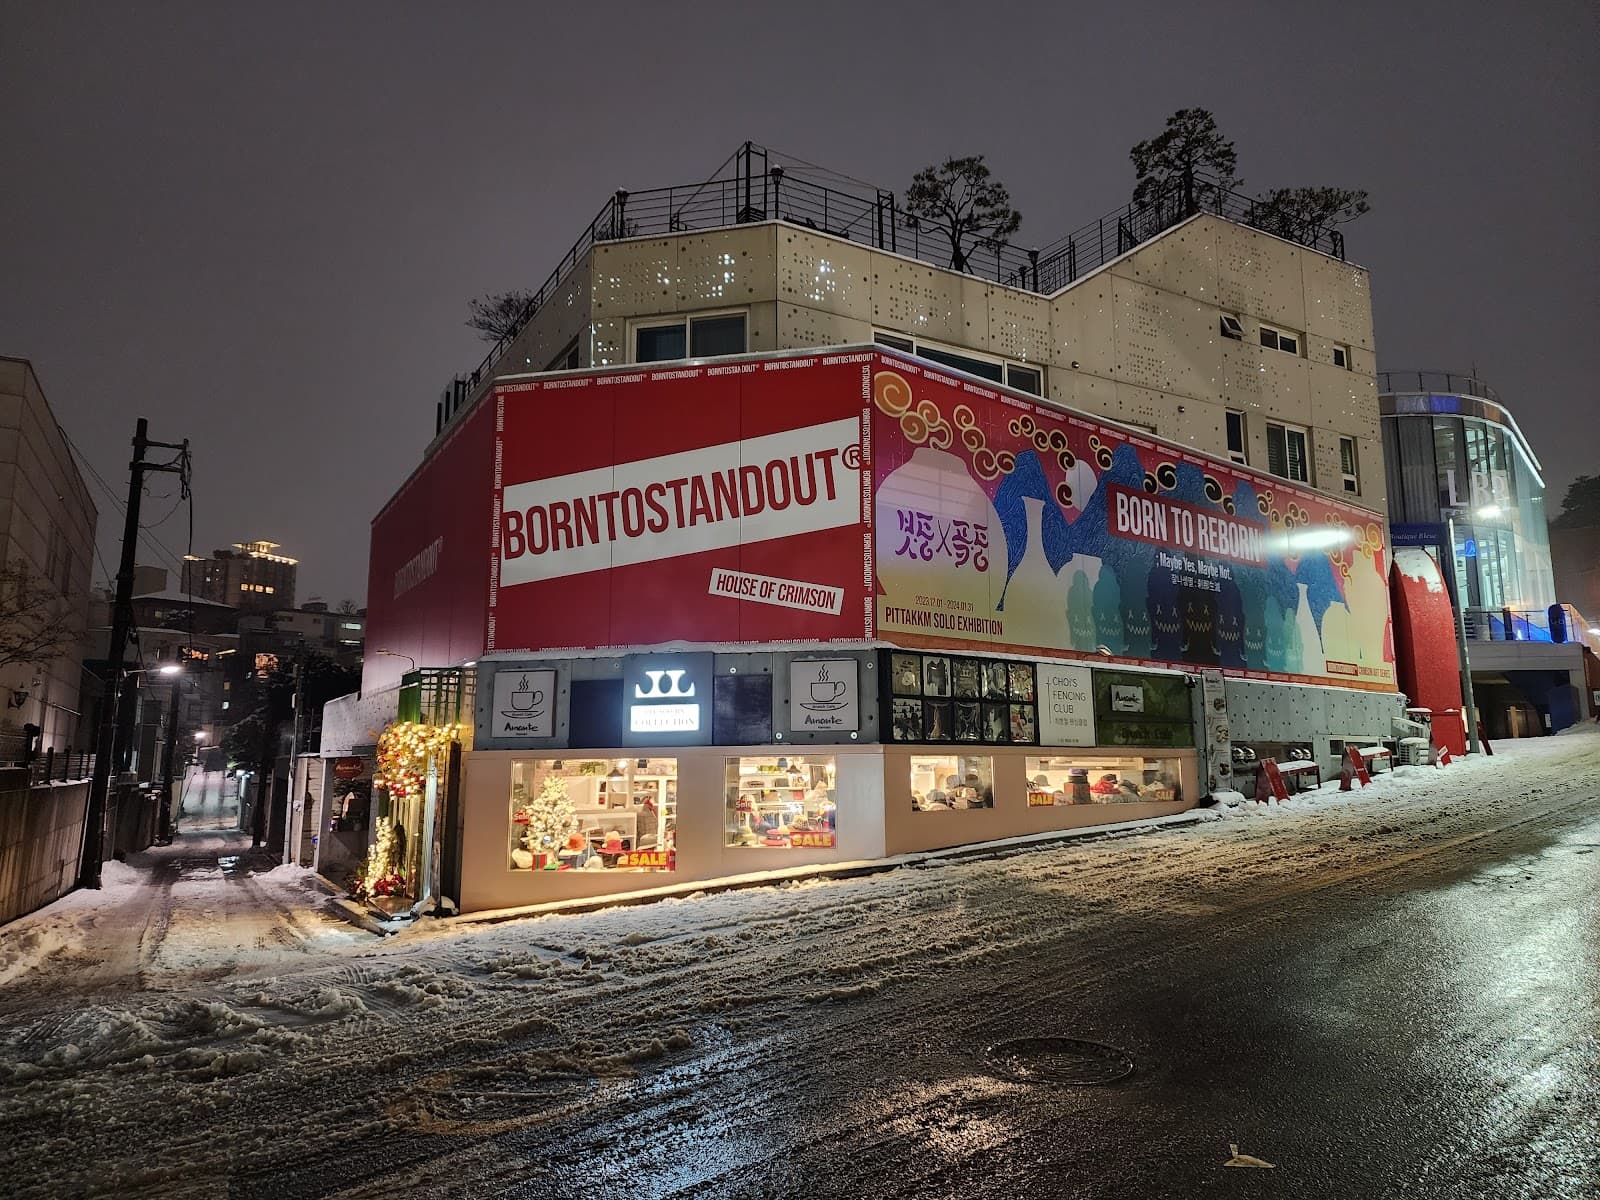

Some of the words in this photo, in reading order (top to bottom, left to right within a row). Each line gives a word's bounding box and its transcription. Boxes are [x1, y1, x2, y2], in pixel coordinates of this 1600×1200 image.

[1116, 492, 1168, 542] BORN
[1171, 506, 1194, 548] TO
[1160, 552, 1182, 571] Maybe
[1198, 560, 1219, 578] Maybe
[1219, 565, 1233, 580] Not.
[716, 574, 758, 596] HOUSE
[760, 580, 776, 598] OF
[778, 584, 836, 610] CRIMSON
[886, 606, 932, 628] PITTAKKM
[934, 613, 955, 630] SOLO
[958, 616, 1003, 636] EXHIBITION
[1053, 690, 1086, 701] FENCING
[1054, 704, 1073, 713] CLUB
[792, 834, 831, 846] SALE
[630, 853, 666, 865] SALE
